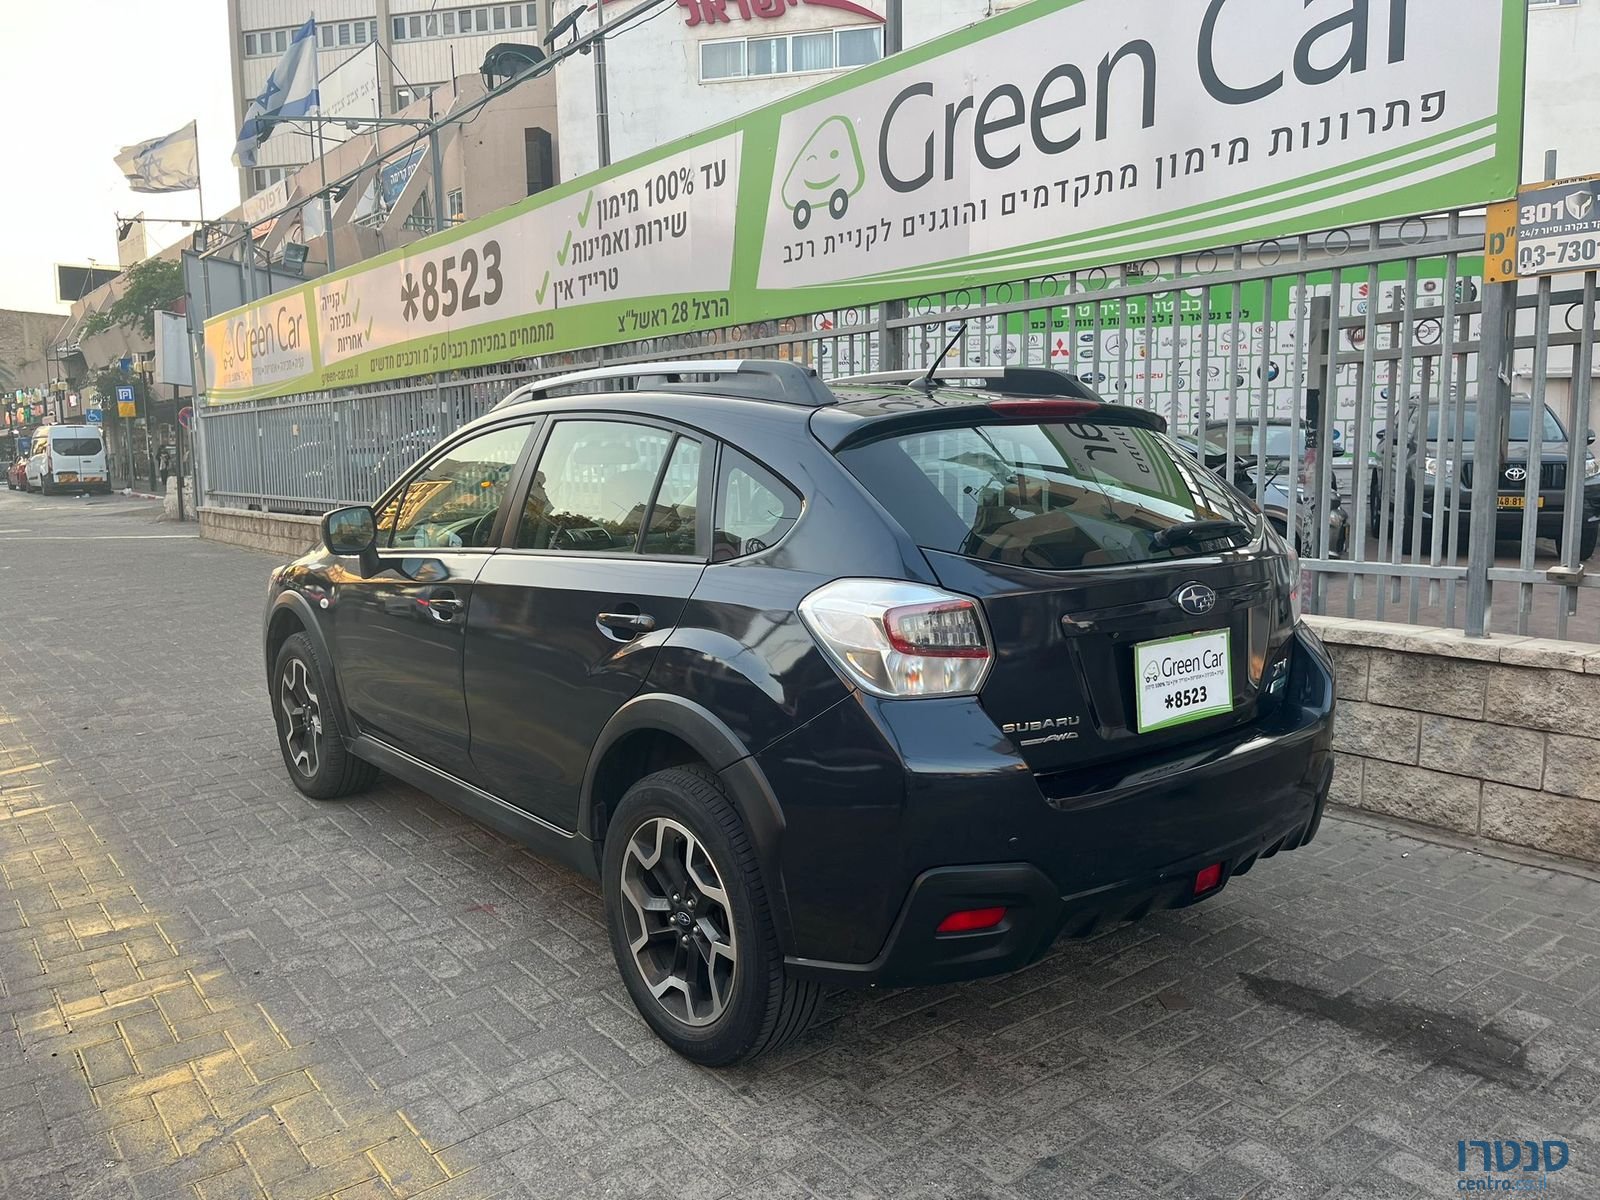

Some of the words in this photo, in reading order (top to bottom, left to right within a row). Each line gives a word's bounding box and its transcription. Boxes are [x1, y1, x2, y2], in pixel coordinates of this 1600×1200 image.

[878, 38, 1157, 194] Green
[1268, 90, 1446, 157] פתרונות
[700, 159, 727, 190] עד
[1155, 137, 1249, 190] מימון
[645, 167, 694, 207] 100%
[1001, 163, 1138, 216] מתקדמים
[597, 188, 639, 230] מימון
[903, 199, 987, 237] והוגנים
[1520, 200, 1564, 225] 301
[634, 211, 687, 249] שירות
[823, 218, 892, 255] לקניית
[1520, 228, 1540, 238] 24/7
[1564, 222, 1589, 232] בקרה
[571, 228, 630, 265] ואמינות
[783, 239, 815, 263] רכב
[553, 278, 574, 309] אין
[578, 267, 619, 297] טרייד
[321, 291, 340, 311] קנייה
[671, 301, 689, 324] 28
[692, 297, 729, 320] הרצל
[1061, 306, 1090, 318] טב
[329, 312, 351, 332] מכירה
[618, 307, 667, 333] ראשל"צ
[1032, 320, 1064, 329] שכם
[1225, 309, 1249, 320] לם
[235, 321, 275, 362] Green
[277, 306, 302, 351] Car
[337, 332, 363, 353] אחריות
[470, 331, 506, 355] במכירת
[509, 322, 554, 347] מתמחים
[1160, 336, 1188, 348] Jep
[396, 349, 421, 369] ורכבים
[423, 343, 439, 365] ק"מ
[440, 342, 447, 361] 0
[448, 341, 468, 359] רכבי
[1220, 344, 1248, 352] TOTA
[370, 354, 395, 372] חדשים
[321, 365, 360, 387] green-car.co.il
[1136, 372, 1164, 380] ISZU
[1162, 657, 1200, 677] Green
[1202, 649, 1224, 669] Car
[1002, 716, 1080, 733] SUBARU
[1043, 732, 1079, 743] AWD
